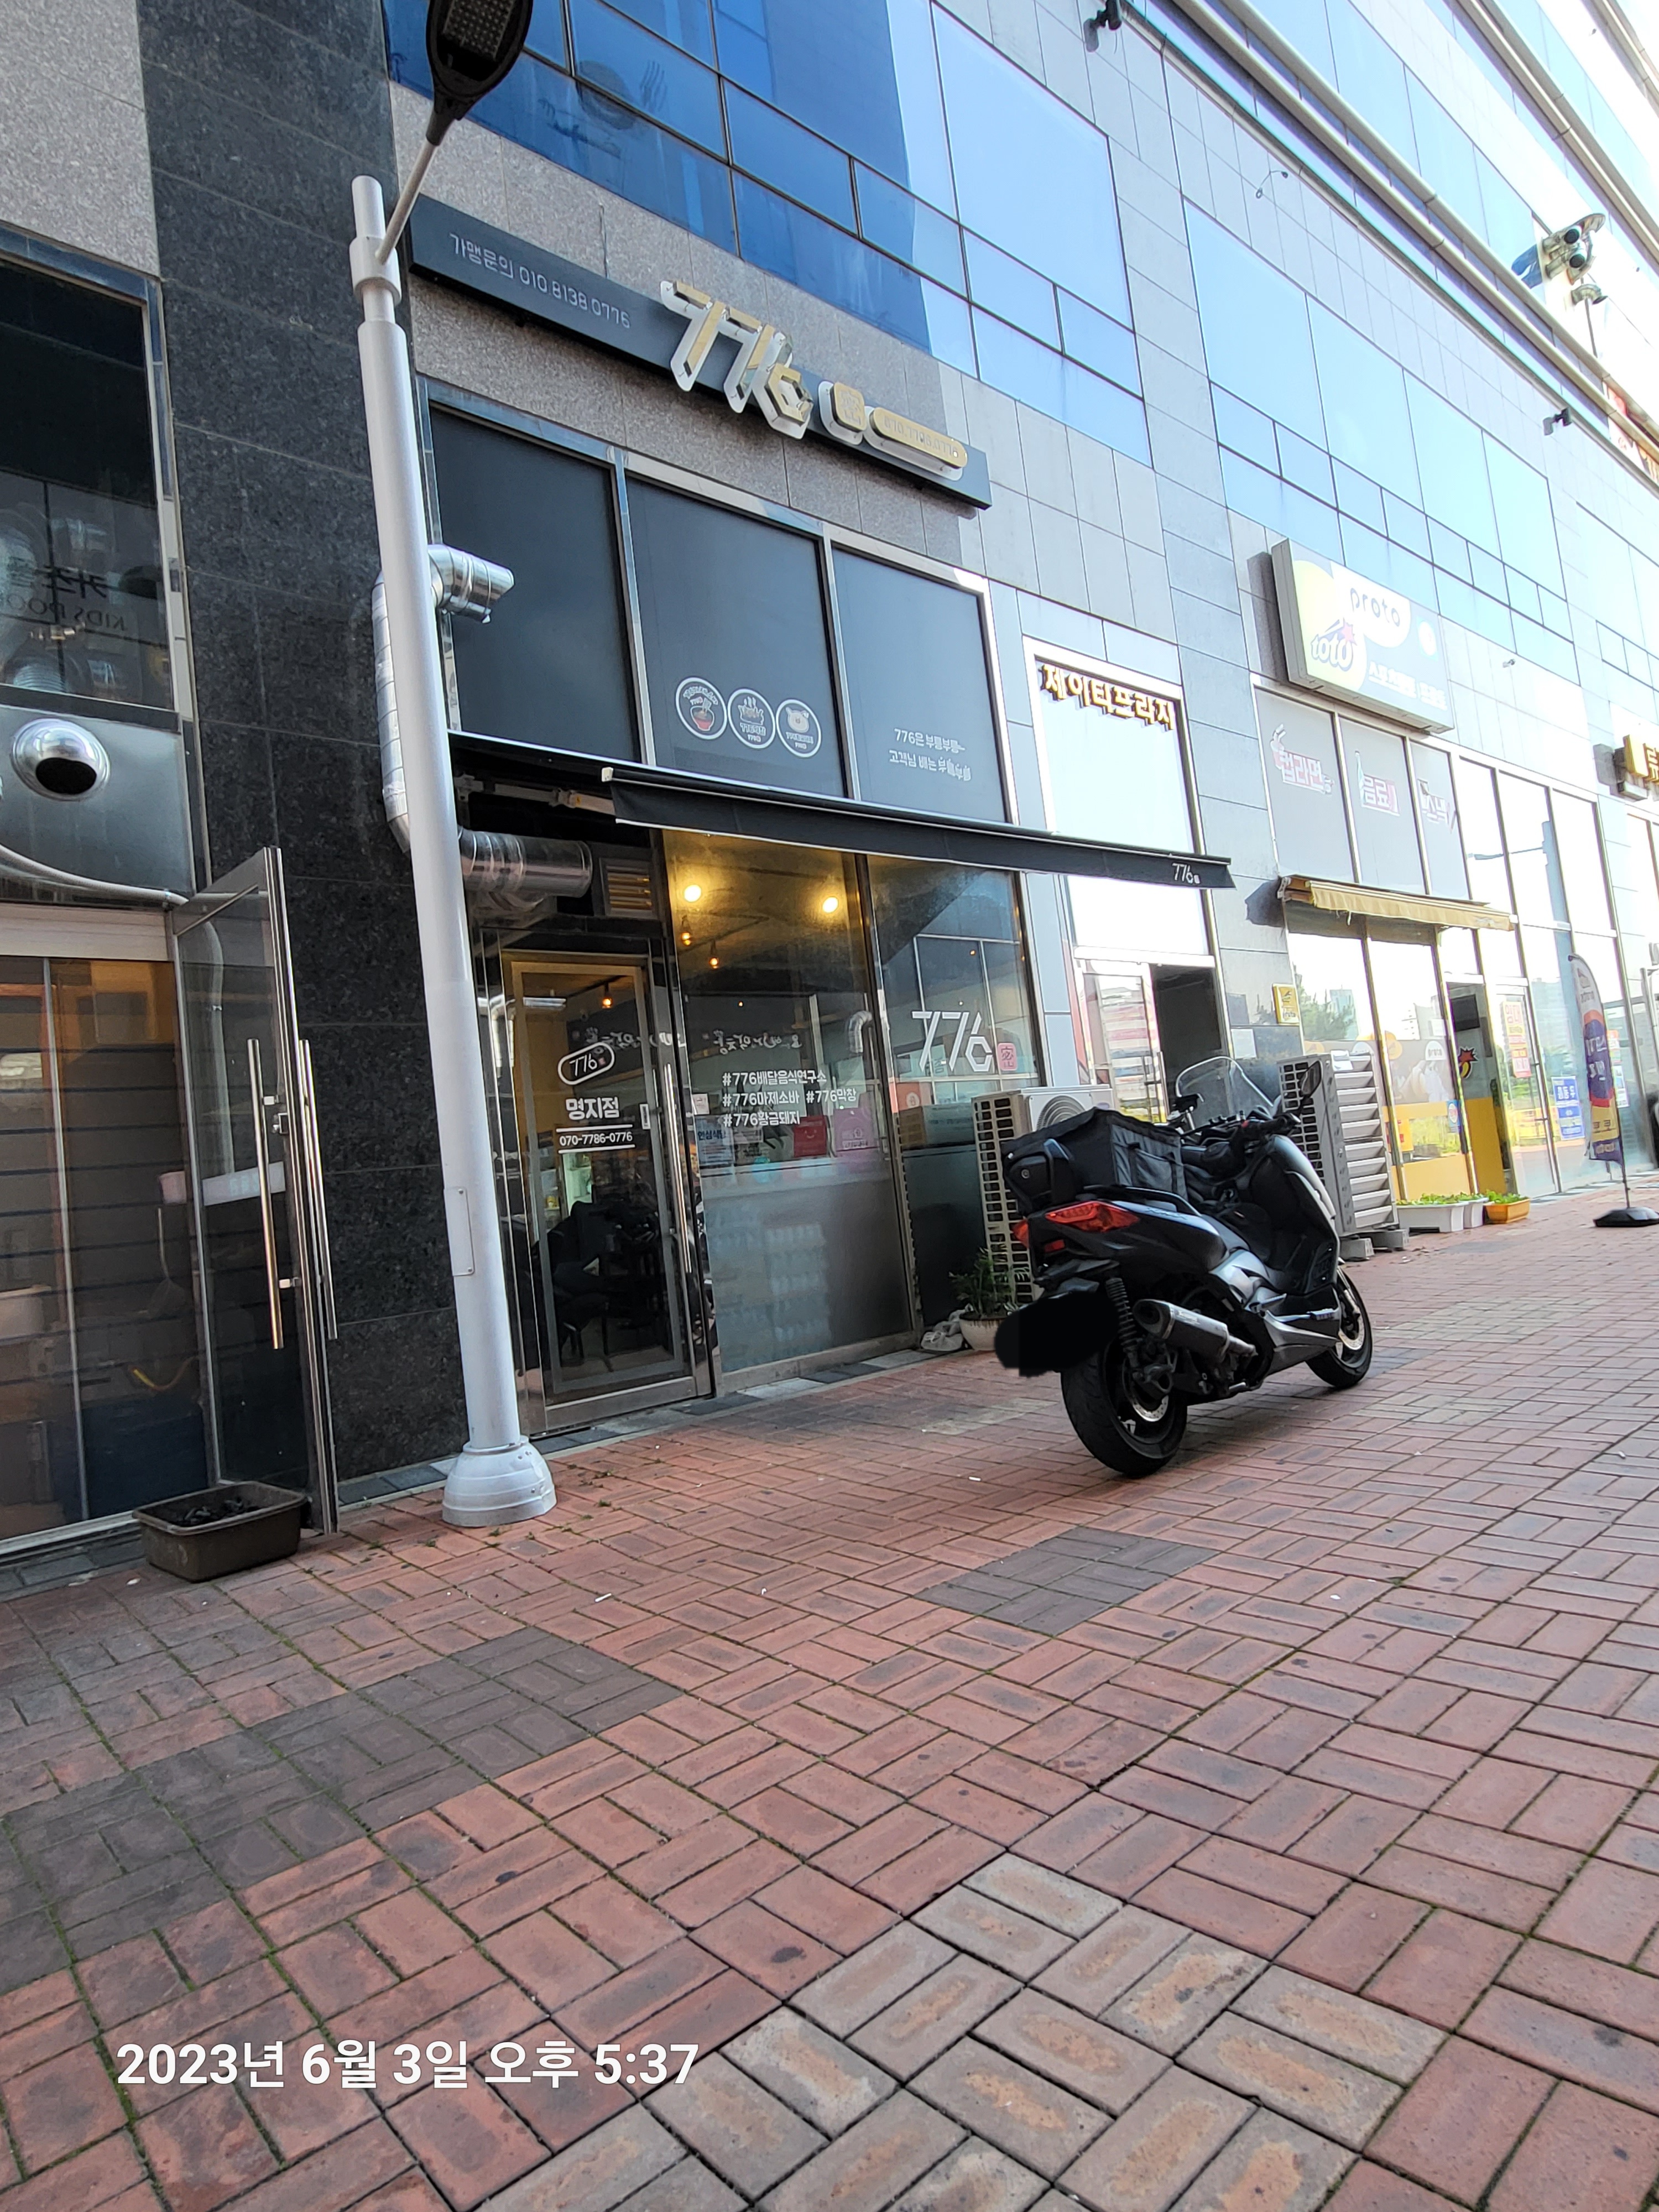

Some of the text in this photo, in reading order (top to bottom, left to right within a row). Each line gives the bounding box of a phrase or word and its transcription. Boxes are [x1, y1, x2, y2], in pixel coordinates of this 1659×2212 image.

[449, 233, 513, 278] 가맹문의
[661, 281, 813, 437] 776
[1350, 587, 1401, 627] proto
[1310, 633, 1354, 672] toto
[894, 728, 925, 747] 776은
[889, 749, 917, 768] 고객님
[918, 755, 937, 772] 배는
[1172, 863, 1193, 884] 776
[912, 1011, 993, 1072] 776
[570, 1053, 598, 1077] 776
[722, 1070, 827, 1086] #776배달음식연구소
[566, 1097, 620, 1120] 명지점
[722, 1088, 857, 1107] #776마제소바 #776막창
[723, 1111, 800, 1127] #776황금돼지
[560, 1131, 633, 1146] 070-7786-0776
